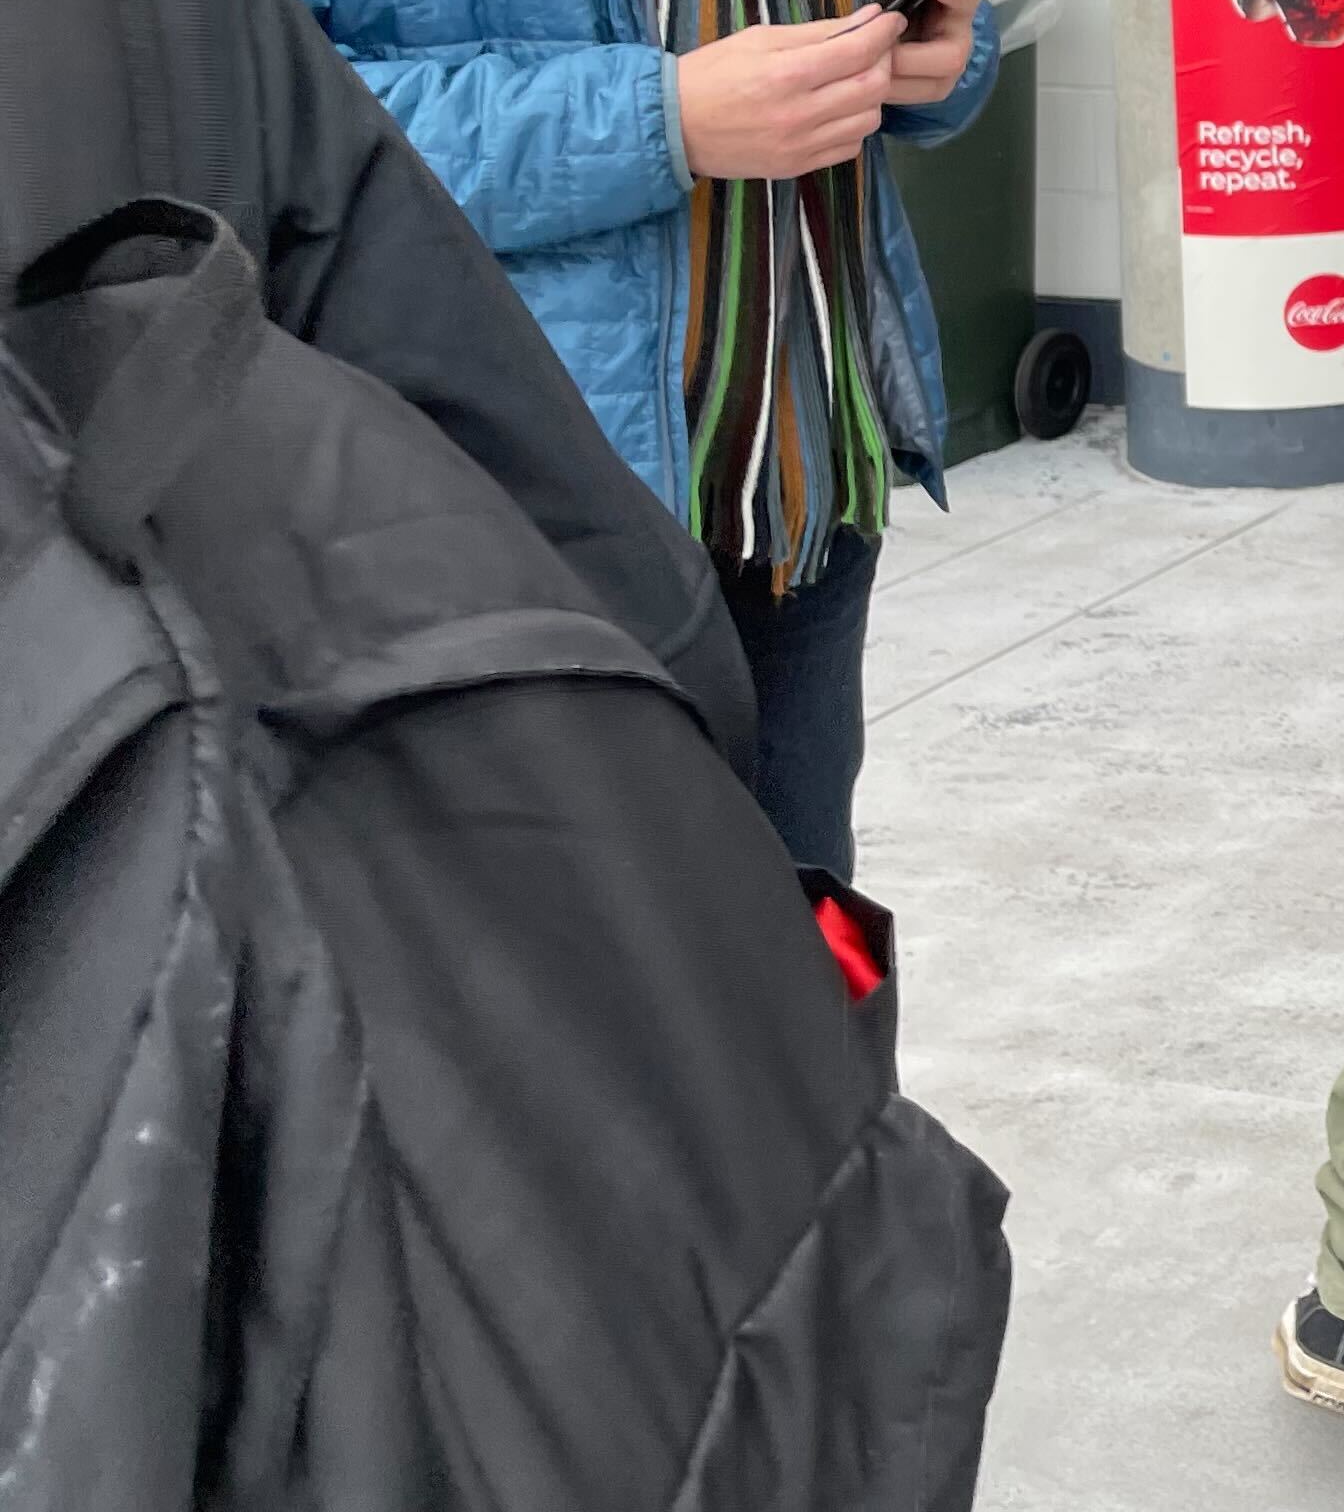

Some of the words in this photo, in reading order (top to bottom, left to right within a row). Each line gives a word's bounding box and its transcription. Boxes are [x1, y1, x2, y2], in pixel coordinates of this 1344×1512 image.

[1197, 119, 1312, 147] Refresh,
[1199, 144, 1304, 171] recycle,
[1199, 169, 1297, 195] repeat.
